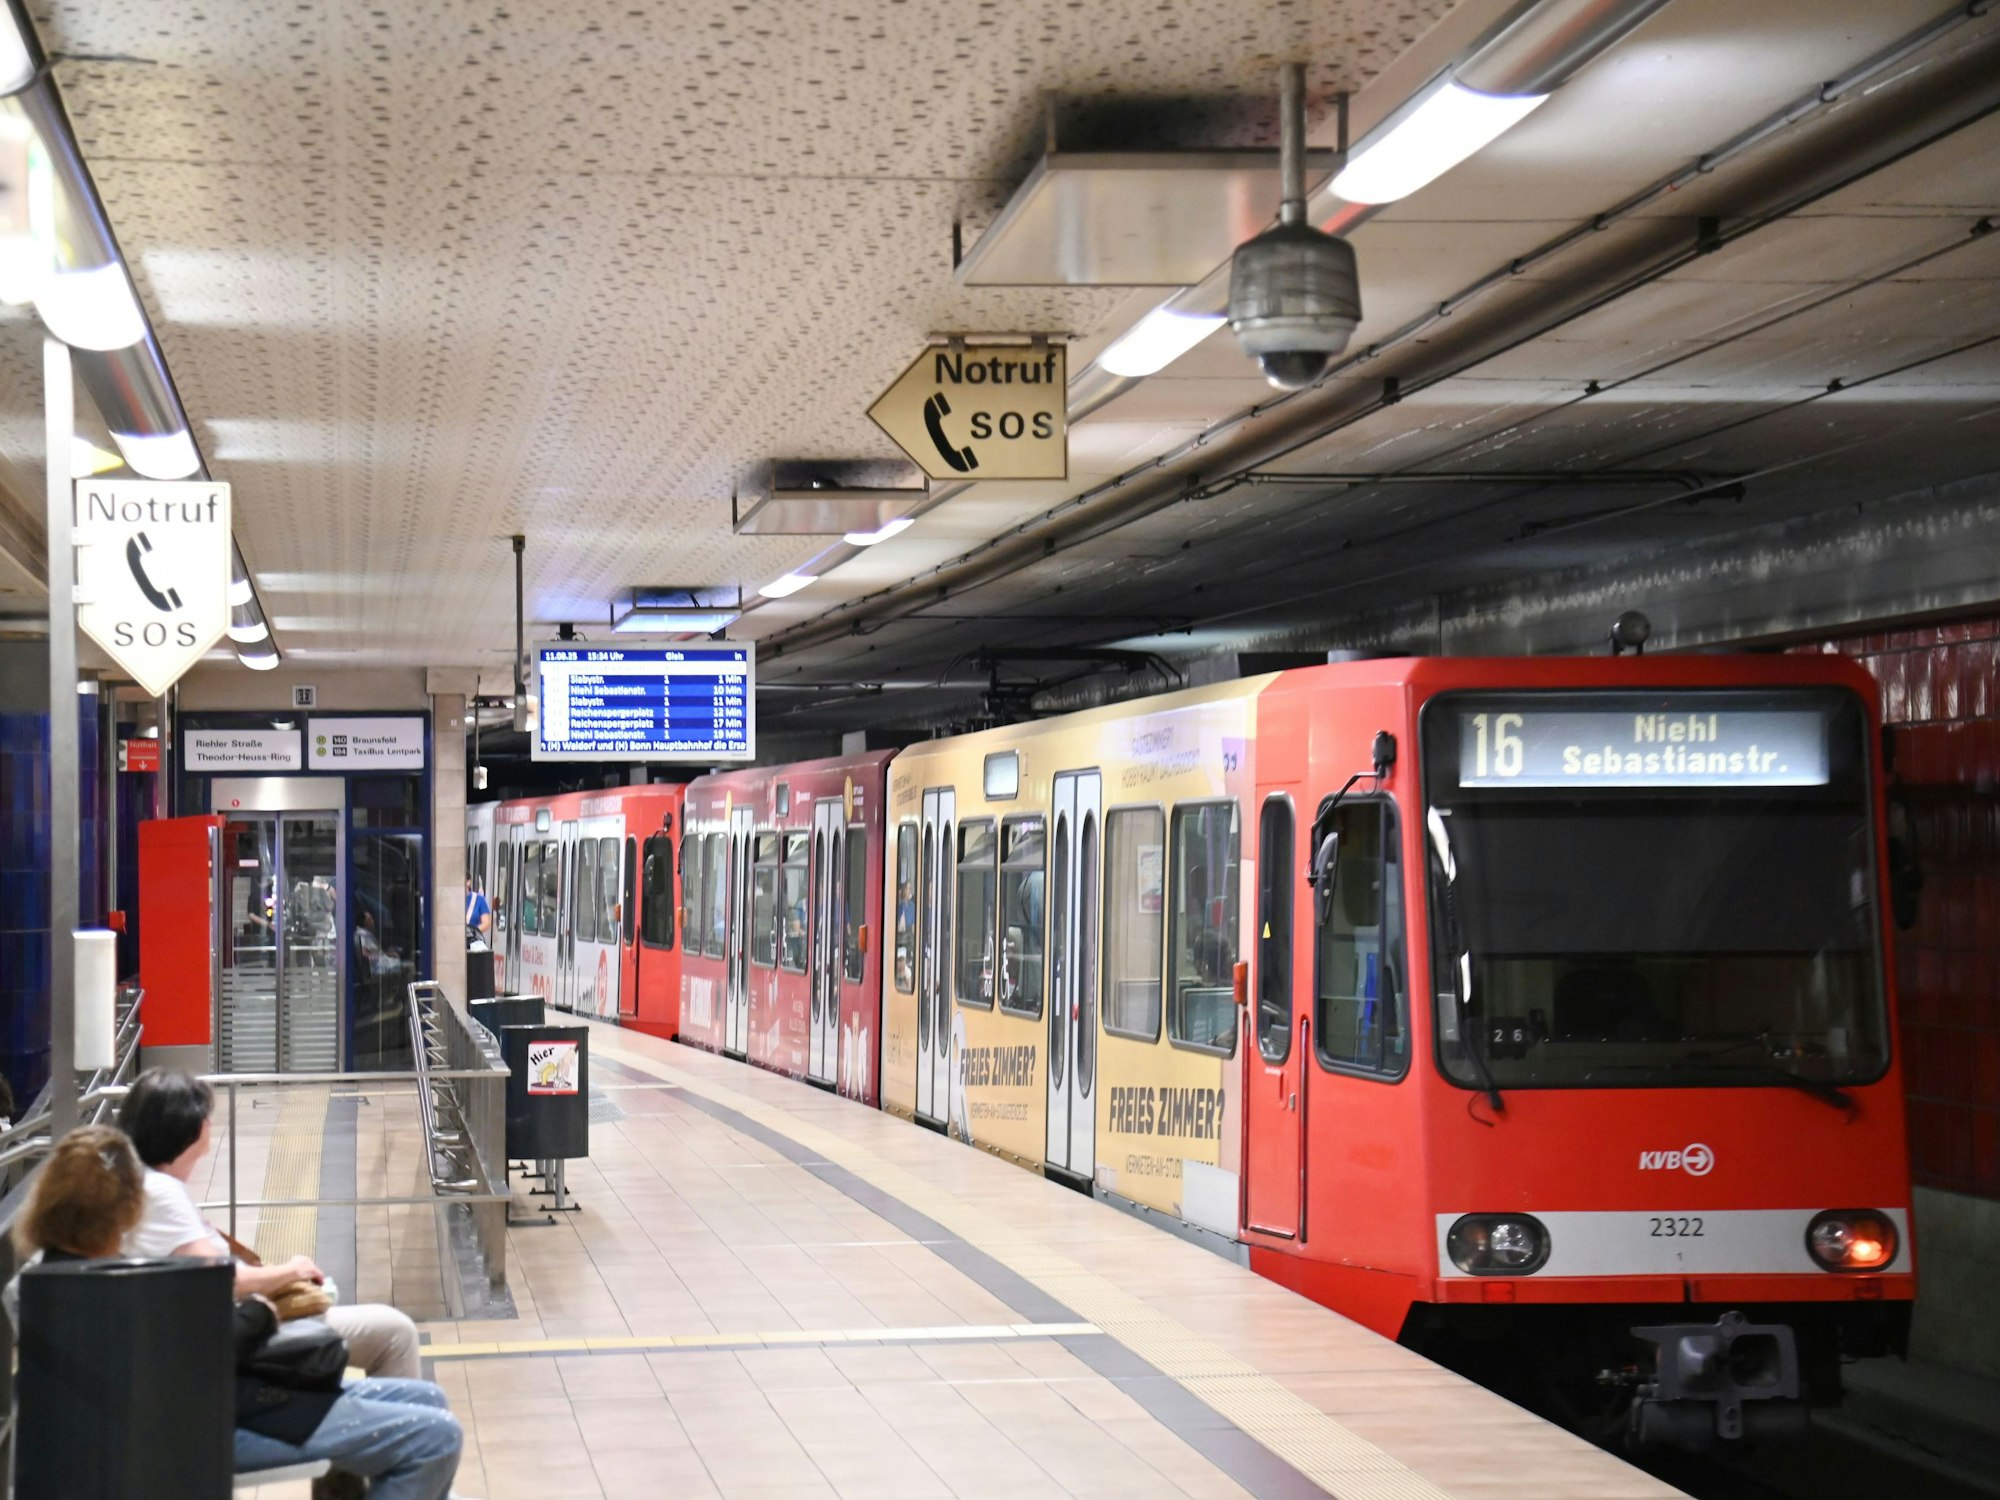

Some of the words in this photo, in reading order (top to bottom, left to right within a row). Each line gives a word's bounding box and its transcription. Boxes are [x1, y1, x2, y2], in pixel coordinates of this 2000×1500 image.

[935, 353, 1056, 384] Notruf
[970, 412, 1053, 439] SOS
[89, 493, 218, 523] Notruf
[114, 622, 196, 647] SOS
[609, 652, 624, 660] Uhr
[665, 652, 684, 660] Gleis
[726, 675, 742, 684] Min
[571, 685, 592, 695] Niehl
[726, 685, 742, 695] Min
[726, 697, 742, 706] Min
[726, 708, 742, 717] Min
[726, 719, 742, 728] Min
[1633, 714, 1717, 742] Niehl
[352, 736, 396, 744] Braunsfeld
[571, 730, 592, 739] Niehl
[726, 730, 742, 739] Min
[196, 740, 227, 748] Riehler
[232, 740, 262, 748] Straße
[597, 741, 614, 750] und
[615, 741, 628, 751] (H)
[630, 741, 651, 750] Bonn
[653, 741, 712, 751] Hauptbahnhof
[714, 741, 726, 750] die
[1472, 713, 1523, 777] 16
[198, 753, 290, 762] Theodor-Heuss-Ring
[388, 748, 421, 756] Lentpark
[1562, 745, 1788, 775] Sebastianstr.
[530, 1047, 555, 1065] Hier
[960, 1047, 990, 1086] FREIES
[992, 1045, 1036, 1086] ZIMMER?
[1109, 1087, 1155, 1135] FREIES
[1157, 1087, 1225, 1140] ZIMMER?
[1638, 1151, 1681, 1169] KVB
[1650, 1218, 1704, 1236] 2322
